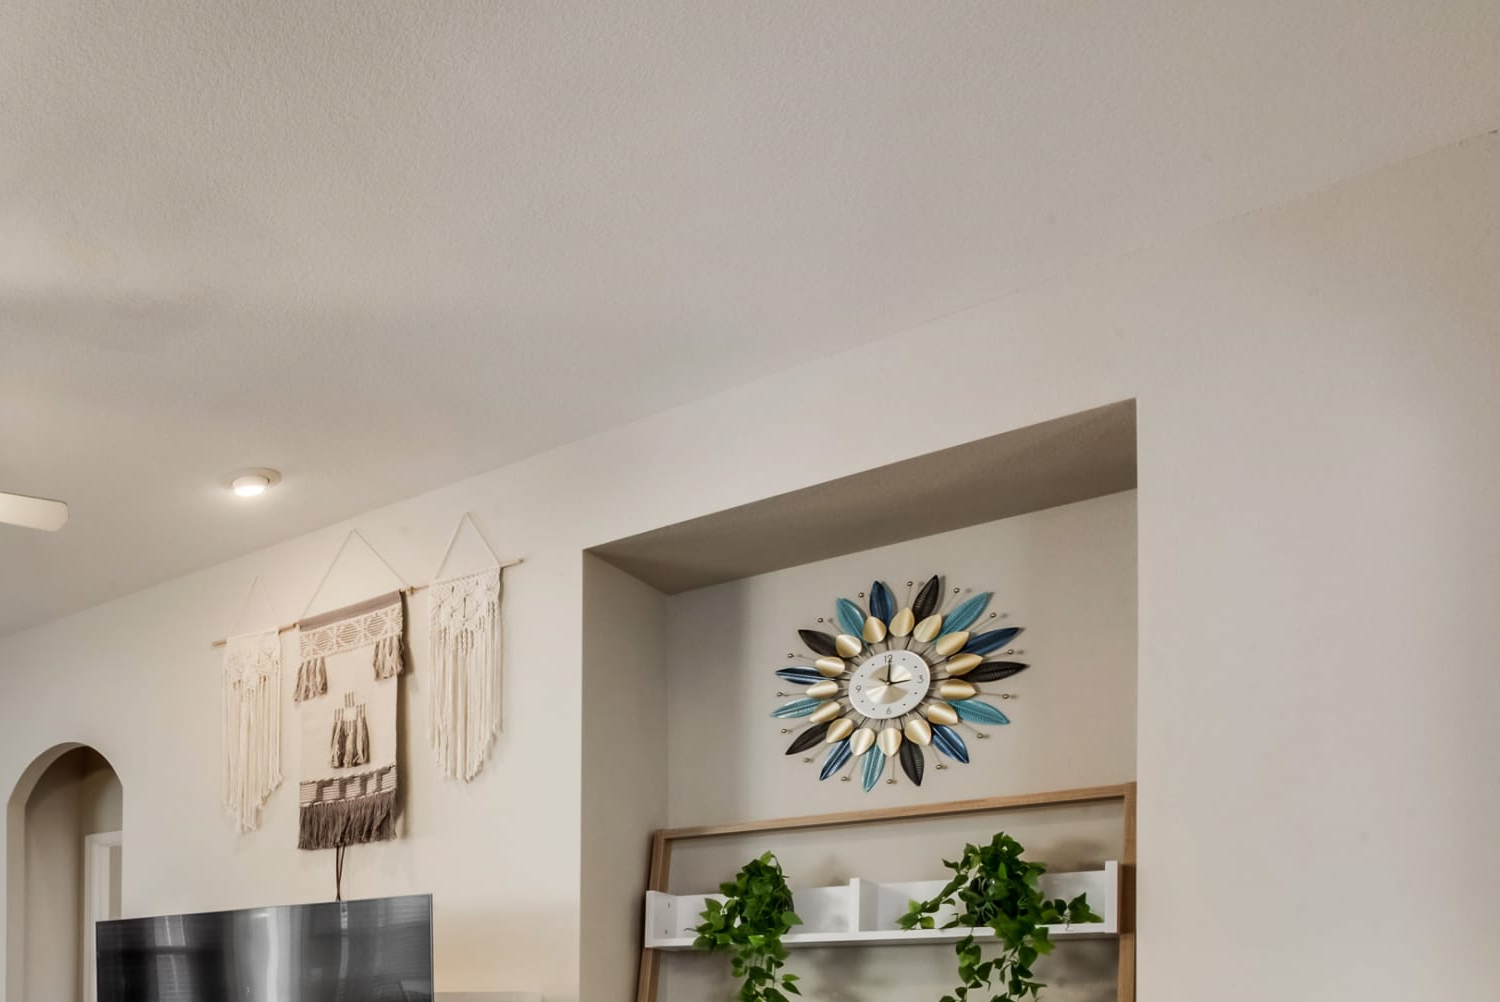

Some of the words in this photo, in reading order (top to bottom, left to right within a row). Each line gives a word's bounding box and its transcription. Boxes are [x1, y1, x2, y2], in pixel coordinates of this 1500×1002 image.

[884, 654, 893, 664] 12
[917, 674, 924, 684] 3
[855, 685, 862, 693] 9
[886, 706, 892, 715] 6
